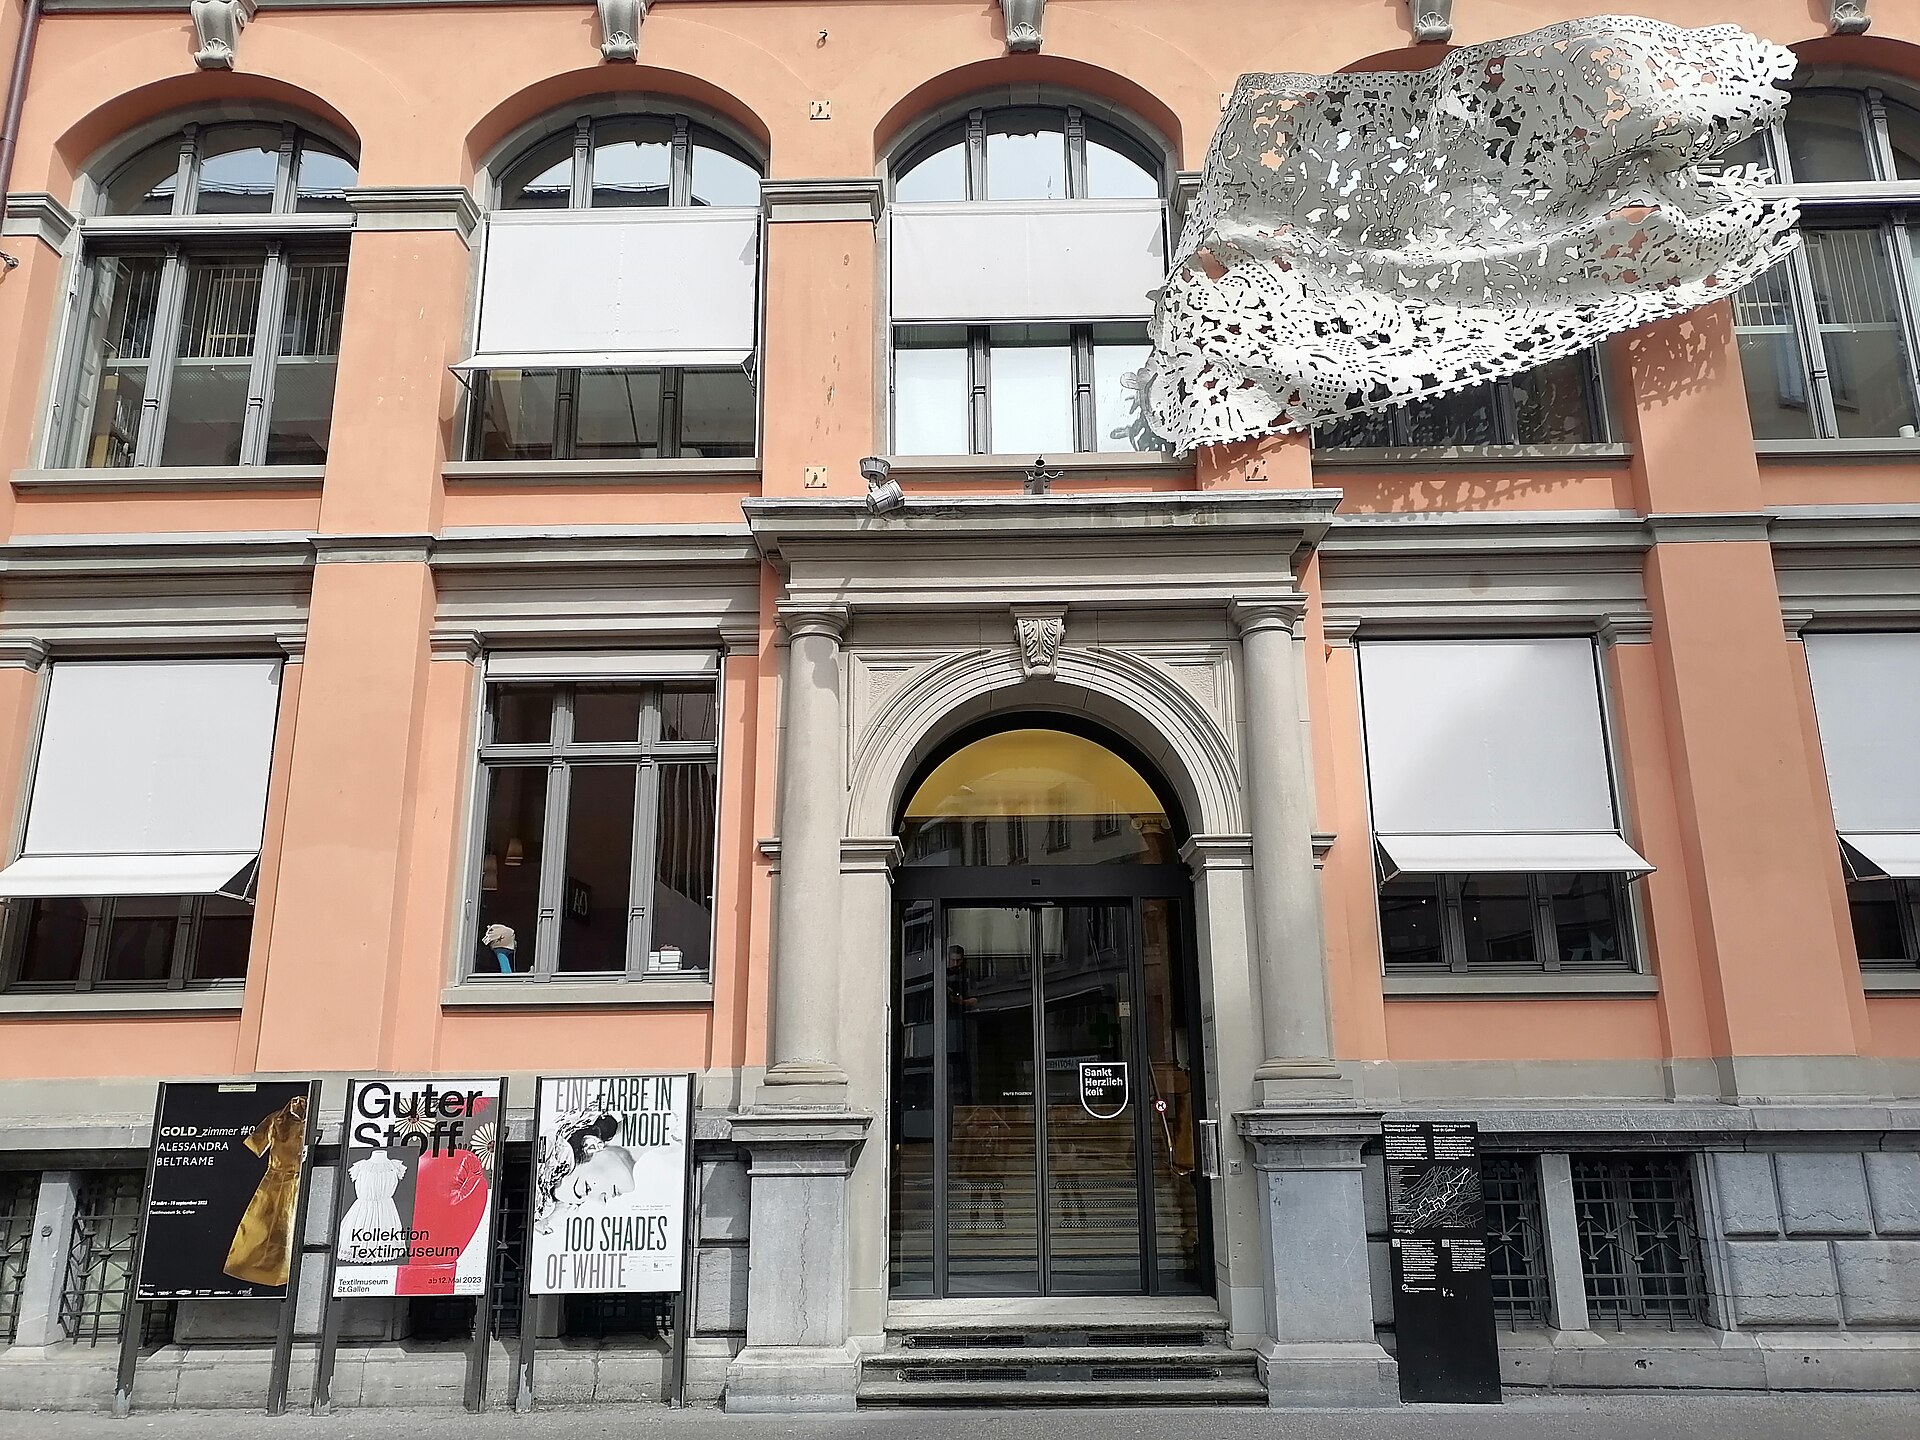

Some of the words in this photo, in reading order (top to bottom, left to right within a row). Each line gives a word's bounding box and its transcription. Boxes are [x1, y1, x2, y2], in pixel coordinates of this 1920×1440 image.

[1084, 1067, 1112, 1077] Sankt
[1085, 1077, 1123, 1087] Herzlich
[556, 1079, 594, 1112] EINE
[598, 1077, 650, 1112] FARBE
[654, 1077, 672, 1111] IN
[1085, 1087, 1104, 1097] keit
[357, 1082, 483, 1119] Guter
[621, 1113, 671, 1147] MODE
[354, 1120, 464, 1158] Stoff
[158, 1142, 229, 1152] ALESSANDRA
[156, 1156, 214, 1167] BELTRAME
[351, 1227, 429, 1241] Kollektion
[565, 1217, 594, 1252] 100
[599, 1216, 668, 1251] SHADES
[350, 1244, 460, 1259] Textilmuseum
[546, 1254, 568, 1289] OF
[573, 1253, 628, 1289] WHITE
[338, 1278, 388, 1286] Textilmuseum
[462, 1276, 482, 1284] 2023
